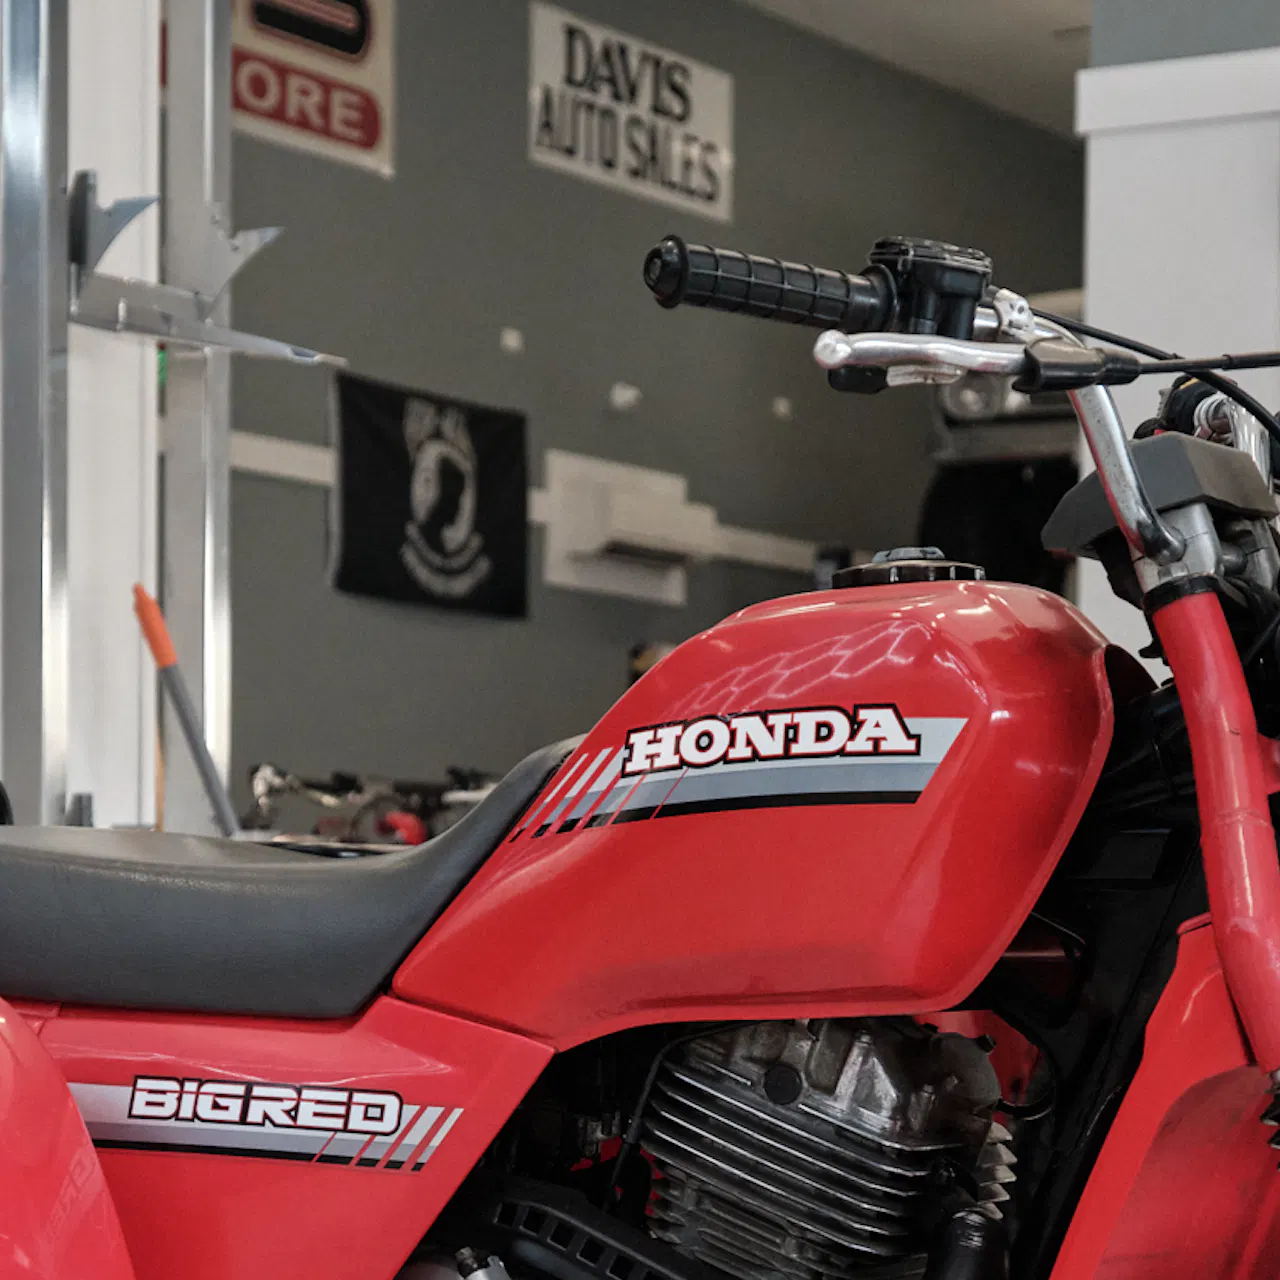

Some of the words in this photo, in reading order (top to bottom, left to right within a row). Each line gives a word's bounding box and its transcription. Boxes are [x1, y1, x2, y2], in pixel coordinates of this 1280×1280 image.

[234, 58, 367, 143] ORE
[564, 22, 690, 122] DAVIS
[535, 82, 619, 170] AUTO
[625, 112, 718, 201] SALES
[621, 704, 921, 777] HONDA
